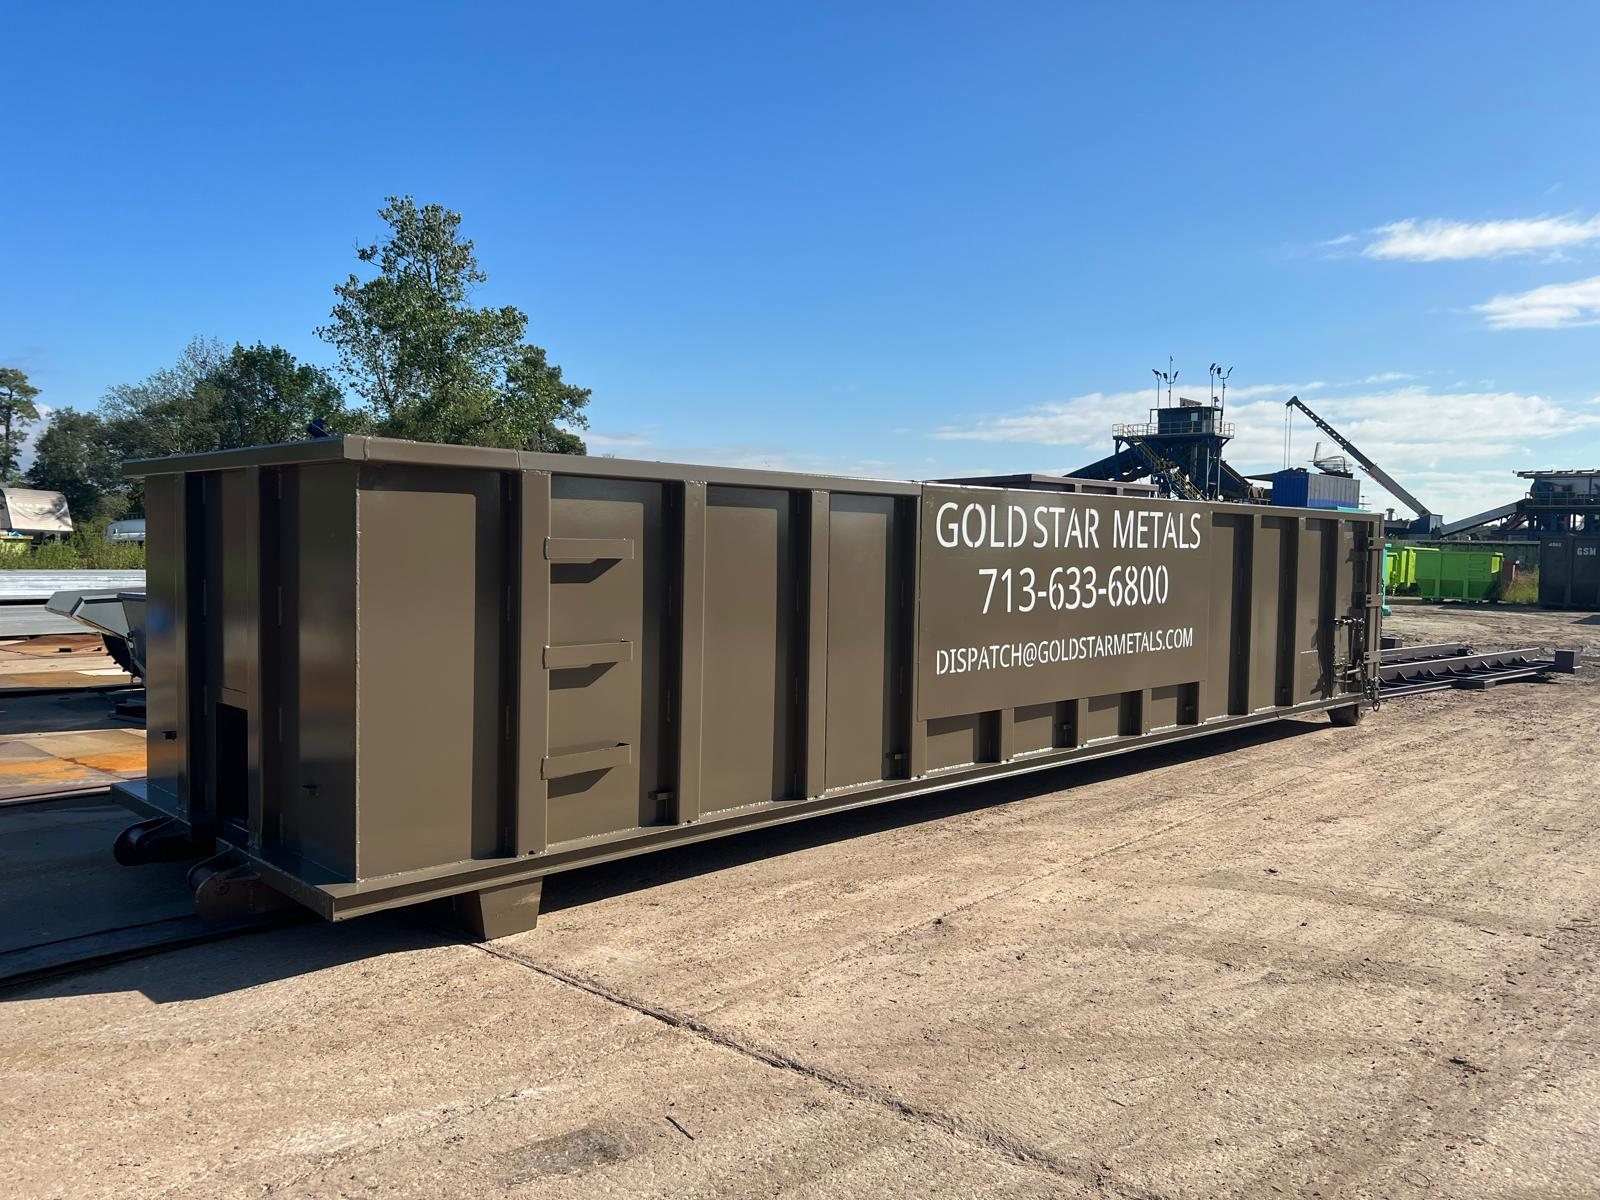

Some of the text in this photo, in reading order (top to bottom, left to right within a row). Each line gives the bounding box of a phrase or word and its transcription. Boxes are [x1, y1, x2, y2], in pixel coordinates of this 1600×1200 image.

[1112, 509, 1201, 549] METALS
[1577, 547, 1597, 556] GSM
[978, 565, 1169, 615] 713-633-6800
[936, 627, 1193, 675] DISPATCH@GOLDSTARMETALS.COM
